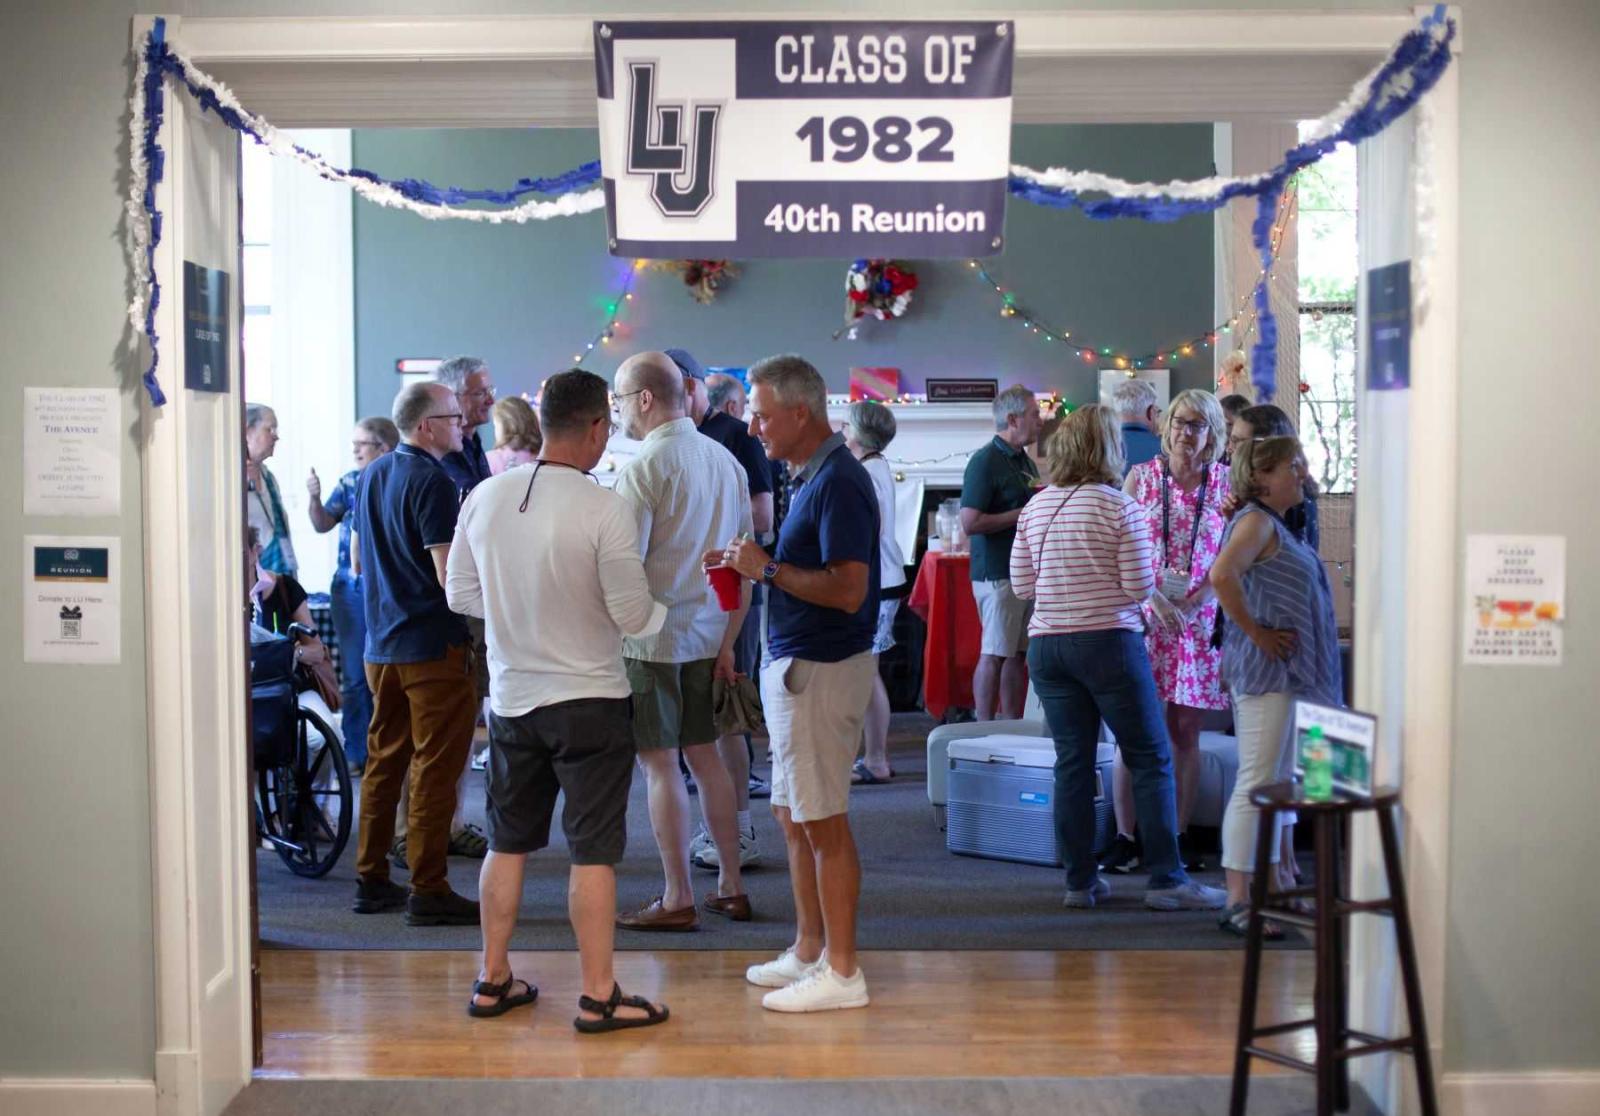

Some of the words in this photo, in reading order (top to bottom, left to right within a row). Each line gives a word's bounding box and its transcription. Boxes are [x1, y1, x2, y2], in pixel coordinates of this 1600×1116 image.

[775, 35, 907, 84] CLASS
[924, 34, 976, 84] OF
[795, 115, 954, 162] 1982
[764, 204, 840, 232] 40th
[852, 203, 985, 232] Reunion
